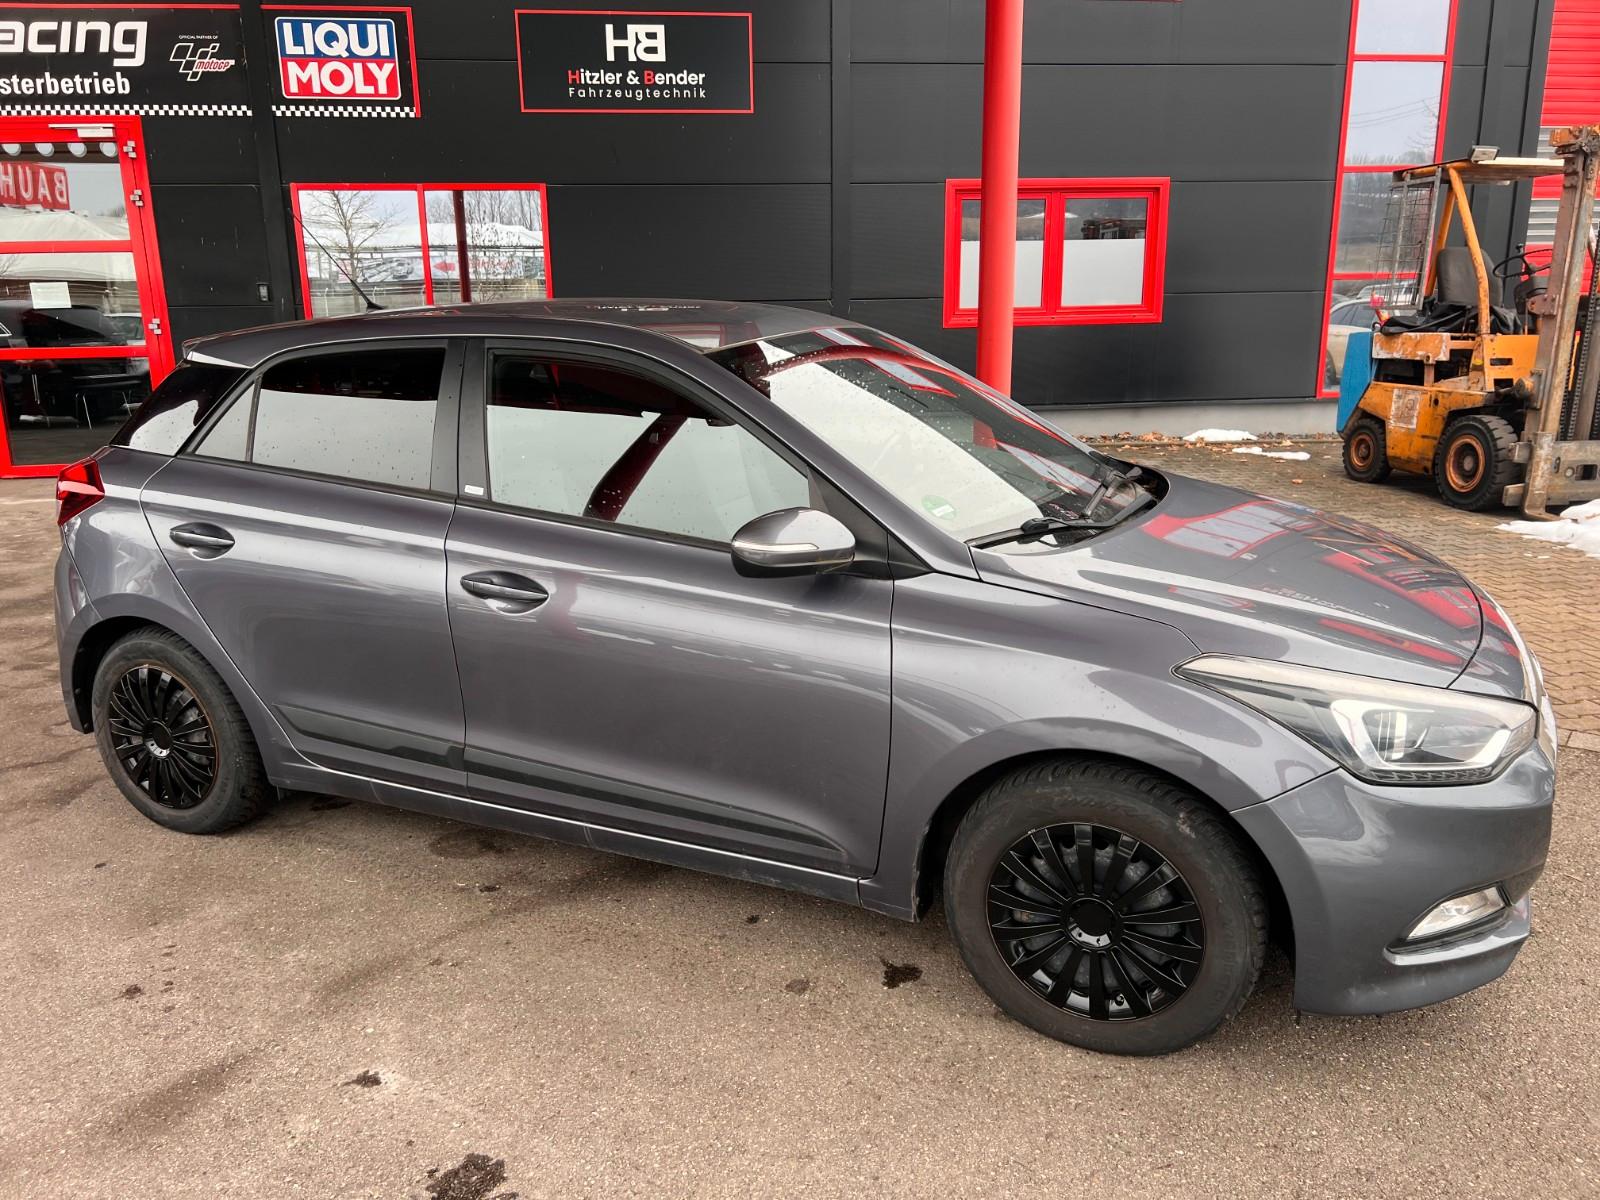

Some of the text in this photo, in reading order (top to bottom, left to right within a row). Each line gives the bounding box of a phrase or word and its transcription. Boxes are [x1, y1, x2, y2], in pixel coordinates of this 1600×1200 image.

[0, 21, 148, 67] acing
[281, 22, 390, 57] LIQUI
[0, 71, 131, 95] sterbetrieb
[286, 61, 394, 95] MOLY
[568, 69, 706, 85] Hitzler & Bender
[568, 87, 706, 101] Fahrzeugtechnik
